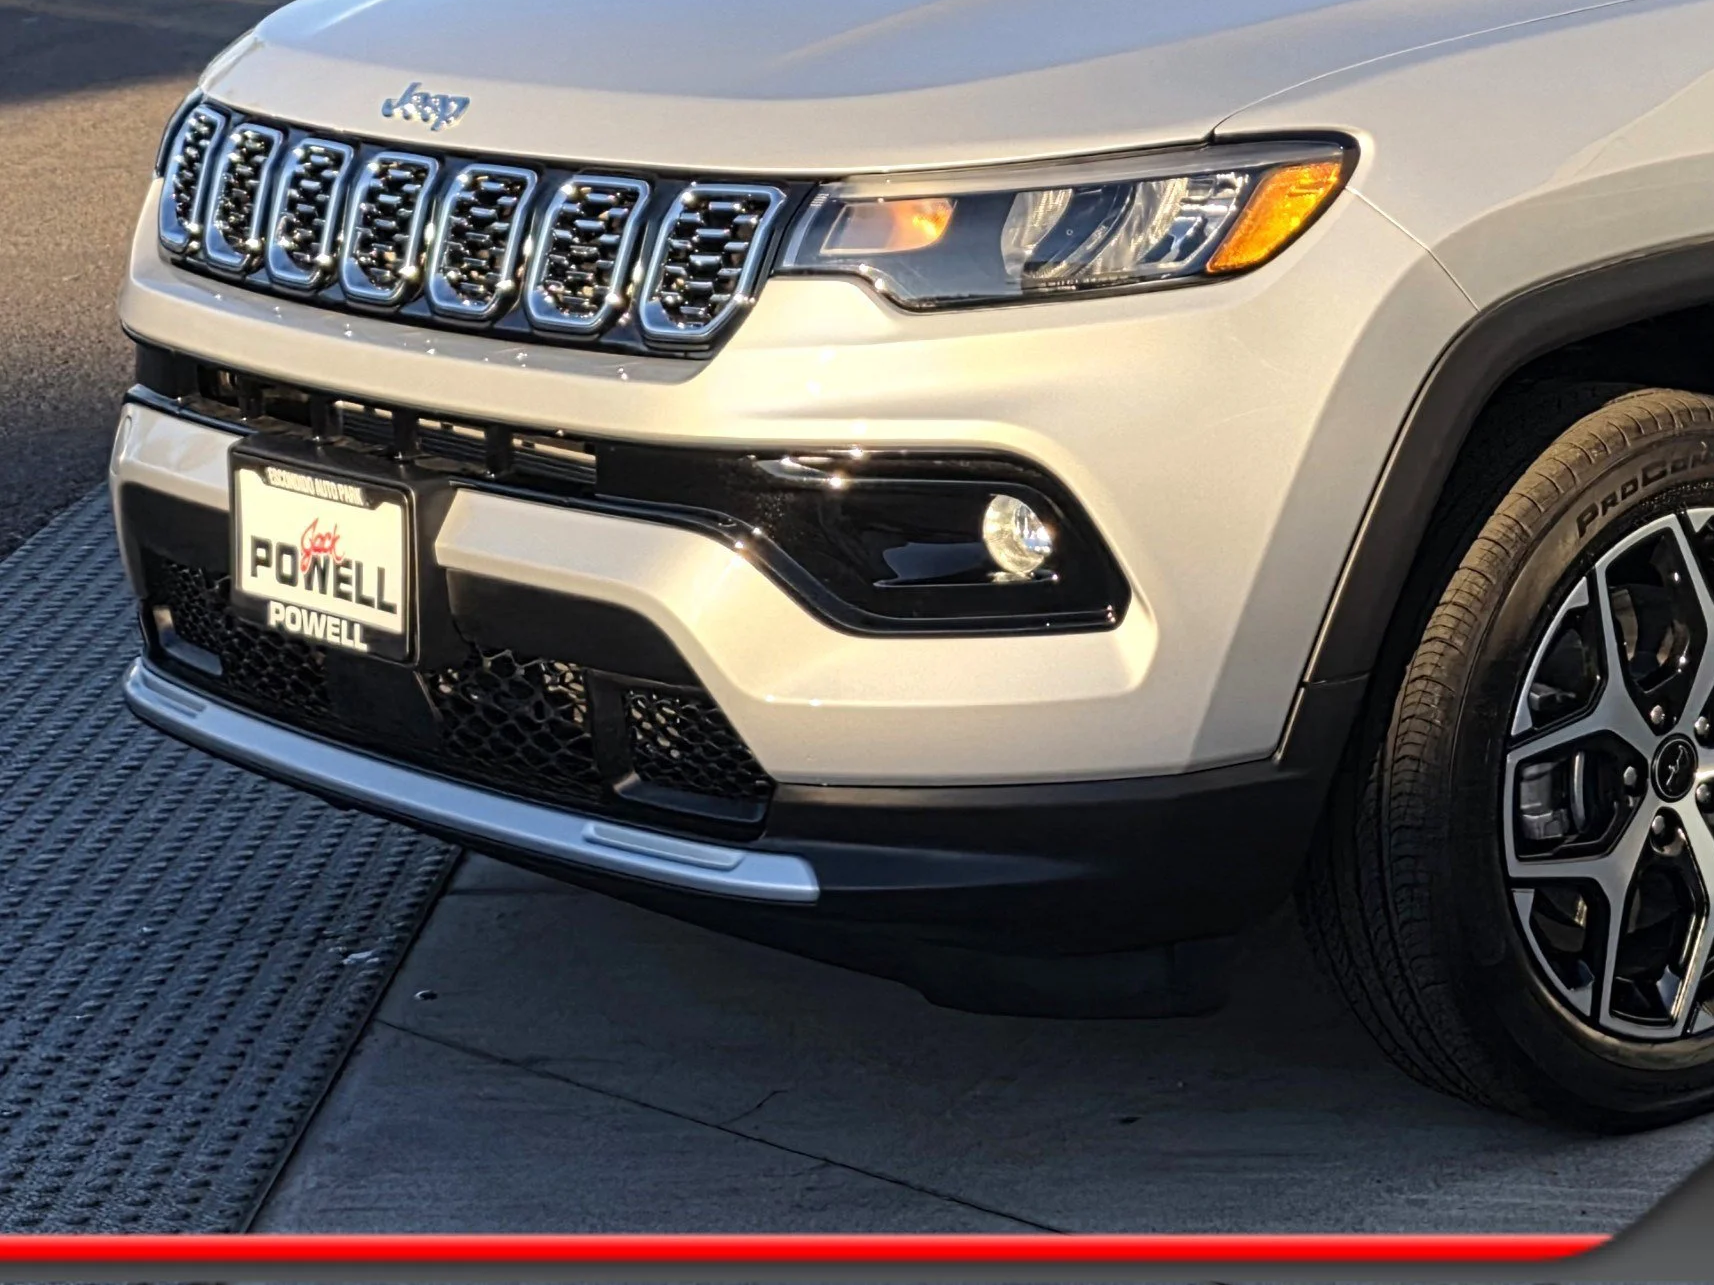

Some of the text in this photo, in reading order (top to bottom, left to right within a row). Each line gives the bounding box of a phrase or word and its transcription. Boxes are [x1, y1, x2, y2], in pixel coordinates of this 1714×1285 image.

[381, 81, 470, 132] Jeep
[314, 478, 339, 501] AUTO
[337, 483, 365, 507] PARK
[301, 518, 346, 573] Jack
[251, 535, 397, 614] POWELL
[268, 601, 368, 651] POWELL
